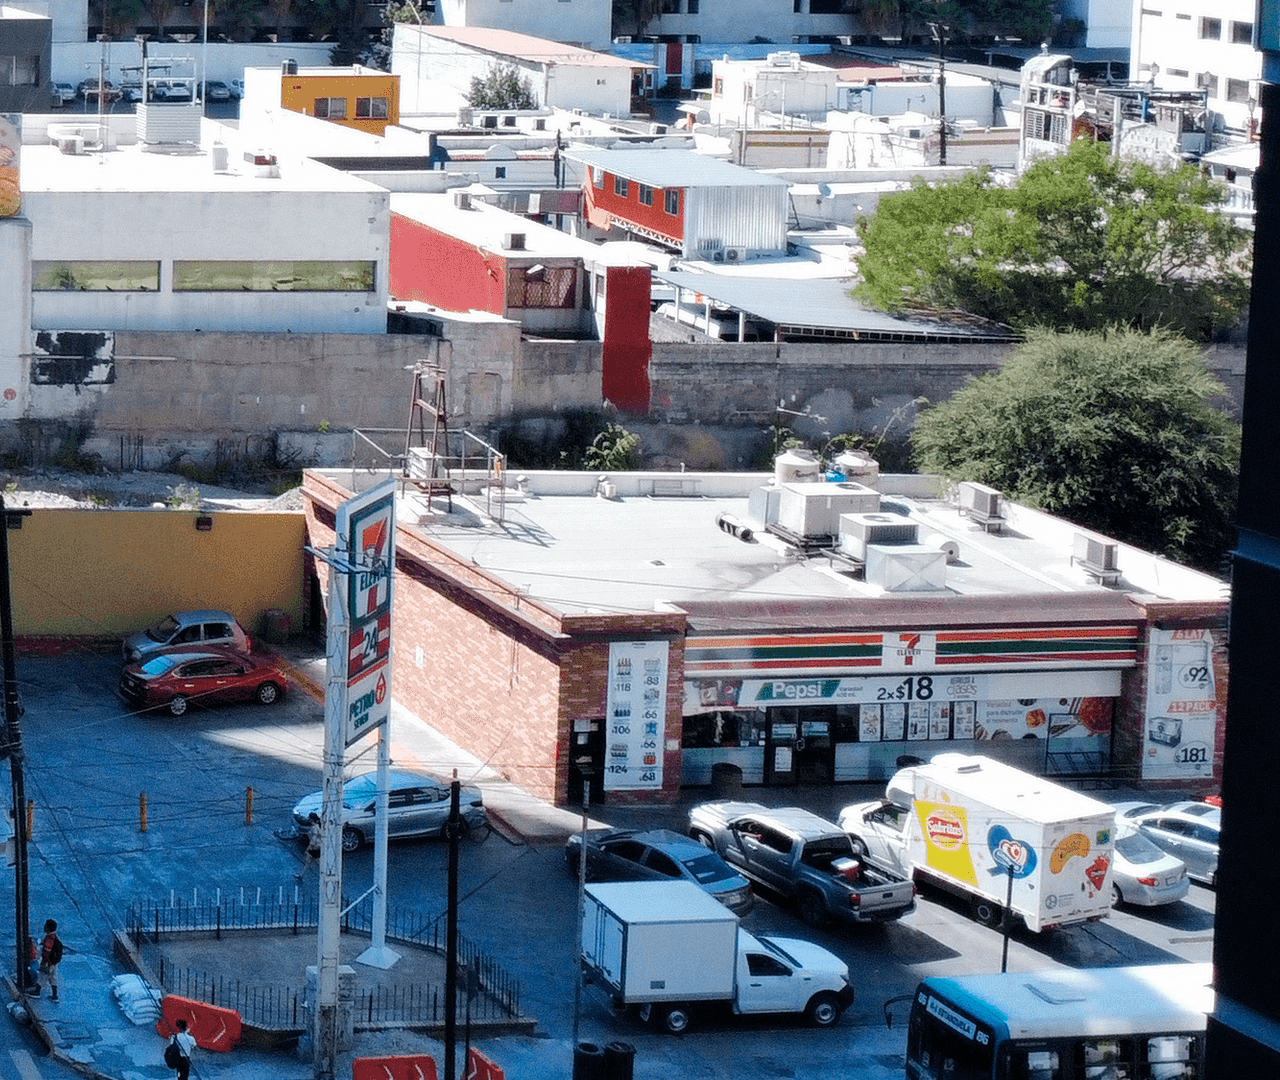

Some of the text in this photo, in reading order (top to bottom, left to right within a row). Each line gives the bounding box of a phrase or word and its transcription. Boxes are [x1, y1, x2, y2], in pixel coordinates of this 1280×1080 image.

[363, 627, 378, 659] 24
[1184, 667, 1208, 682] $92
[1175, 748, 1207, 763] $181
